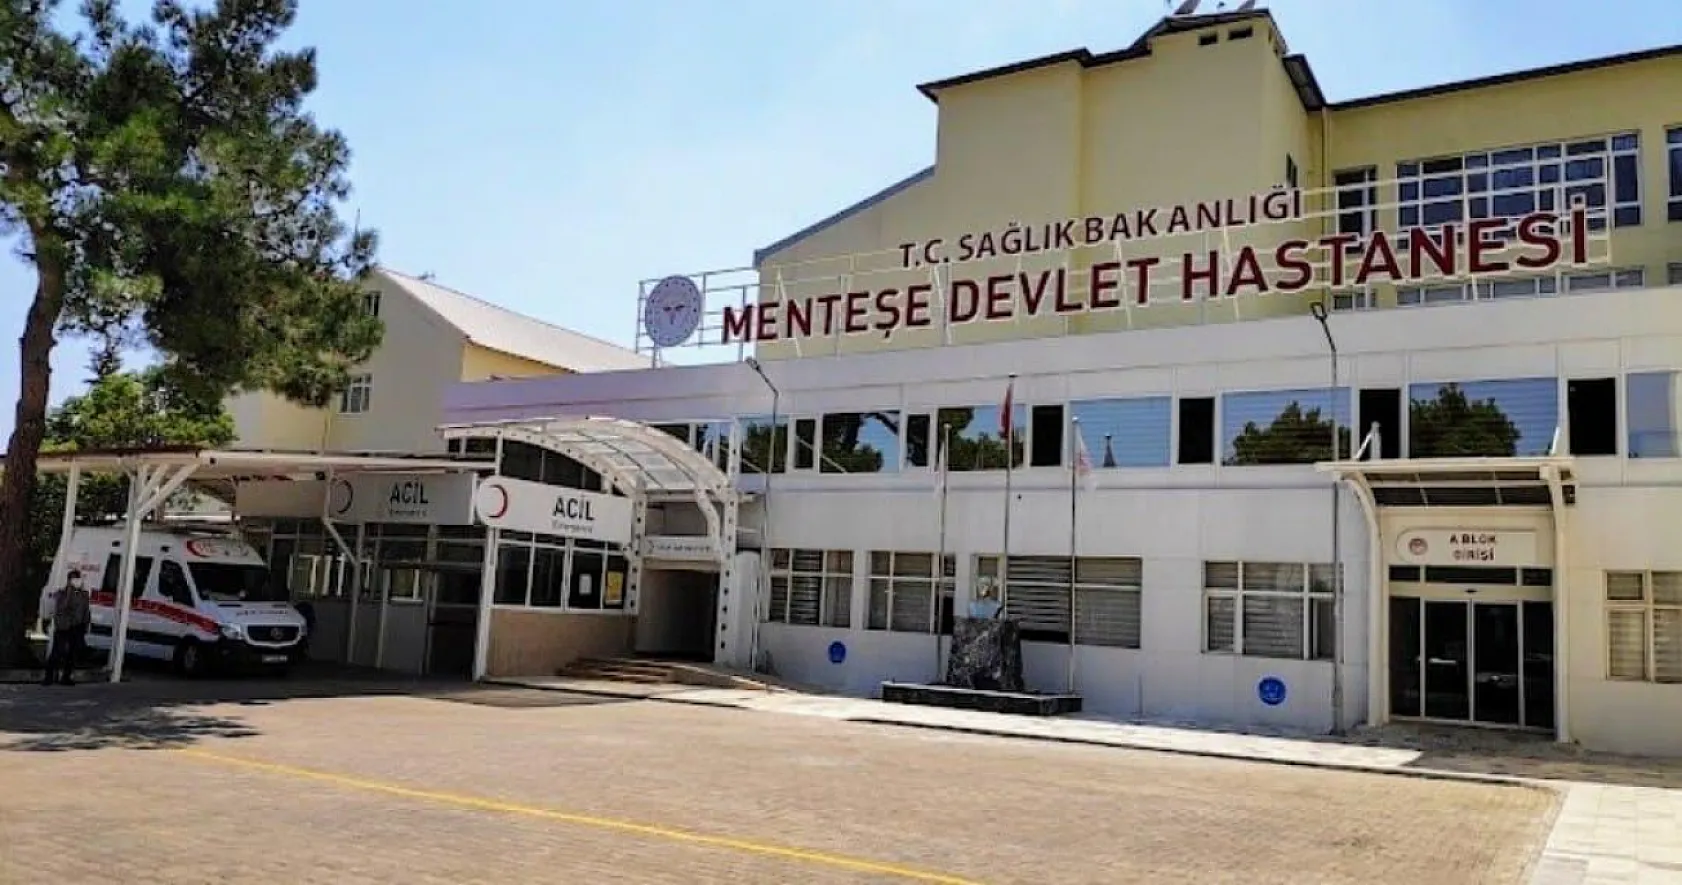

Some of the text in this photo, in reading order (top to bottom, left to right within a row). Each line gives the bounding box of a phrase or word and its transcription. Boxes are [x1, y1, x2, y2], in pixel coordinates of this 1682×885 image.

[900, 185, 1300, 268] T.C. SAĞLIK BAKANLIĞI
[723, 284, 932, 343] MENTEŞE
[950, 257, 1159, 323] DEVLET
[1183, 195, 1586, 299] HASTANESİ
[389, 478, 429, 505] ACİL
[552, 495, 596, 521] ACİL
[1450, 533, 1496, 544] A BLOK
